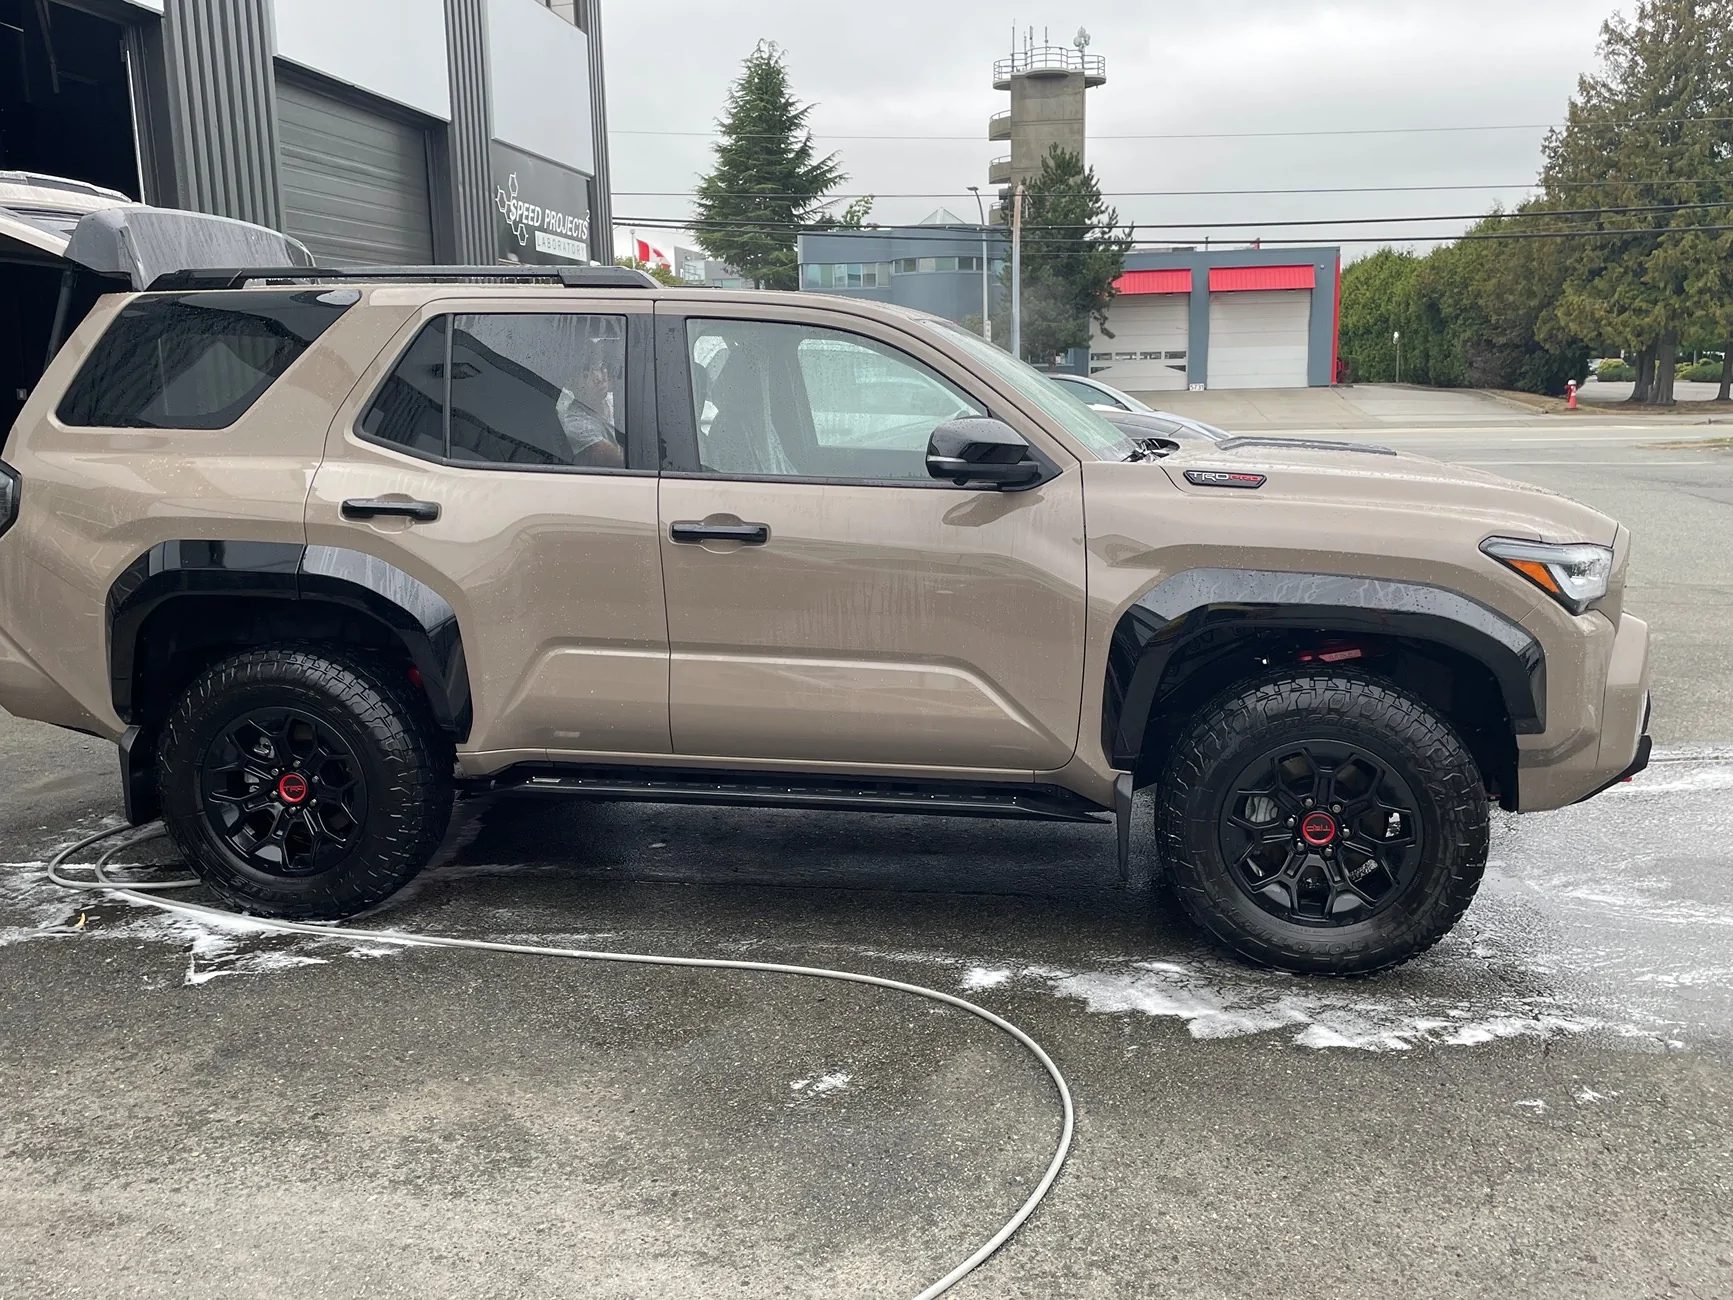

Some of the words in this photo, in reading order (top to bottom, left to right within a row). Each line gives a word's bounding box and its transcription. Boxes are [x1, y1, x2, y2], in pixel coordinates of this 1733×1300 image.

[509, 199, 542, 227] SPEED
[537, 235, 585, 258] LABORATORY
[1188, 471, 1230, 482] TRD
[283, 785, 304, 793] TRD
